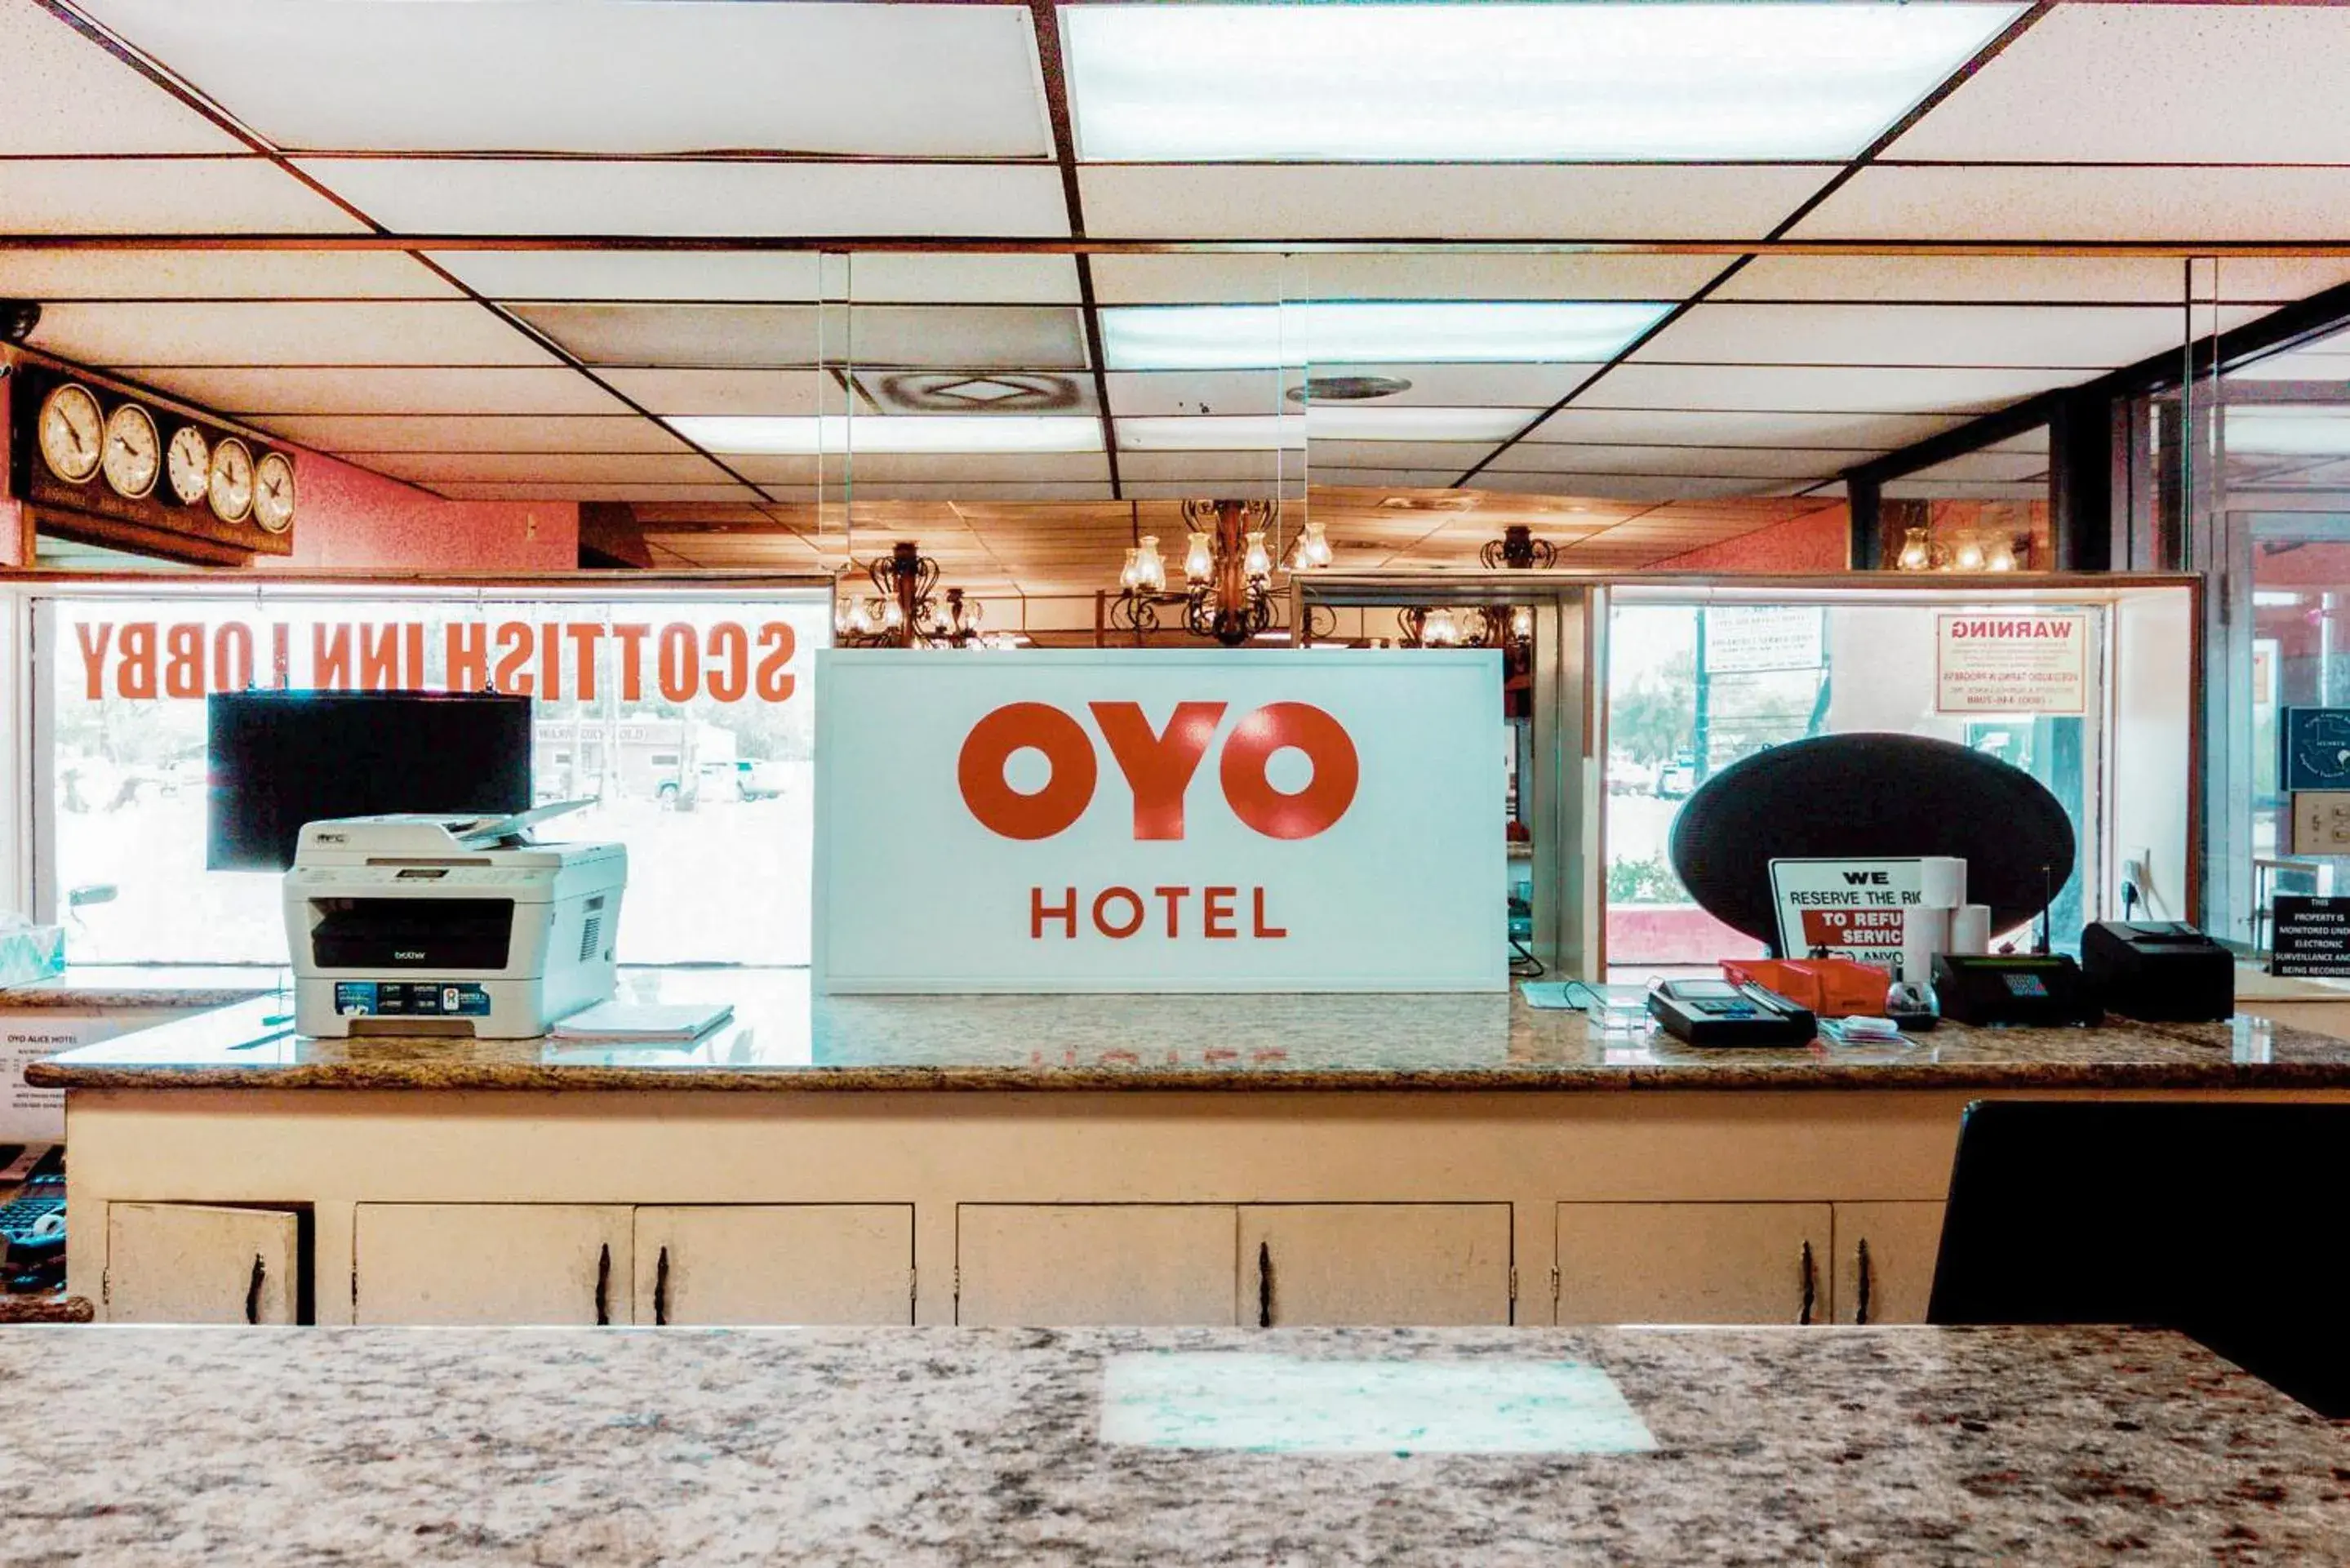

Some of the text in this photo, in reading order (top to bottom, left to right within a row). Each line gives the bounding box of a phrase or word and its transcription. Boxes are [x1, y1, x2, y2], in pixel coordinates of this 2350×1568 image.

[957, 701, 1359, 841] OYO
[1843, 872, 1890, 885] WE
[1790, 891, 1860, 905] RESERVE
[1866, 891, 1896, 904] THE
[1031, 886, 1287, 939] HOTEL
[1821, 913, 1902, 926] TO REFU
[1841, 930, 1902, 944] SERVIC
[2279, 926, 2329, 935] MONITORED
[2294, 939, 2343, 948] ELECTRONIC
[1863, 951, 1904, 964] ANYO
[2276, 953, 2333, 962] SURVEILLANCE
[7, 1035, 26, 1044] OYO
[51, 1035, 78, 1045] HOTEL
